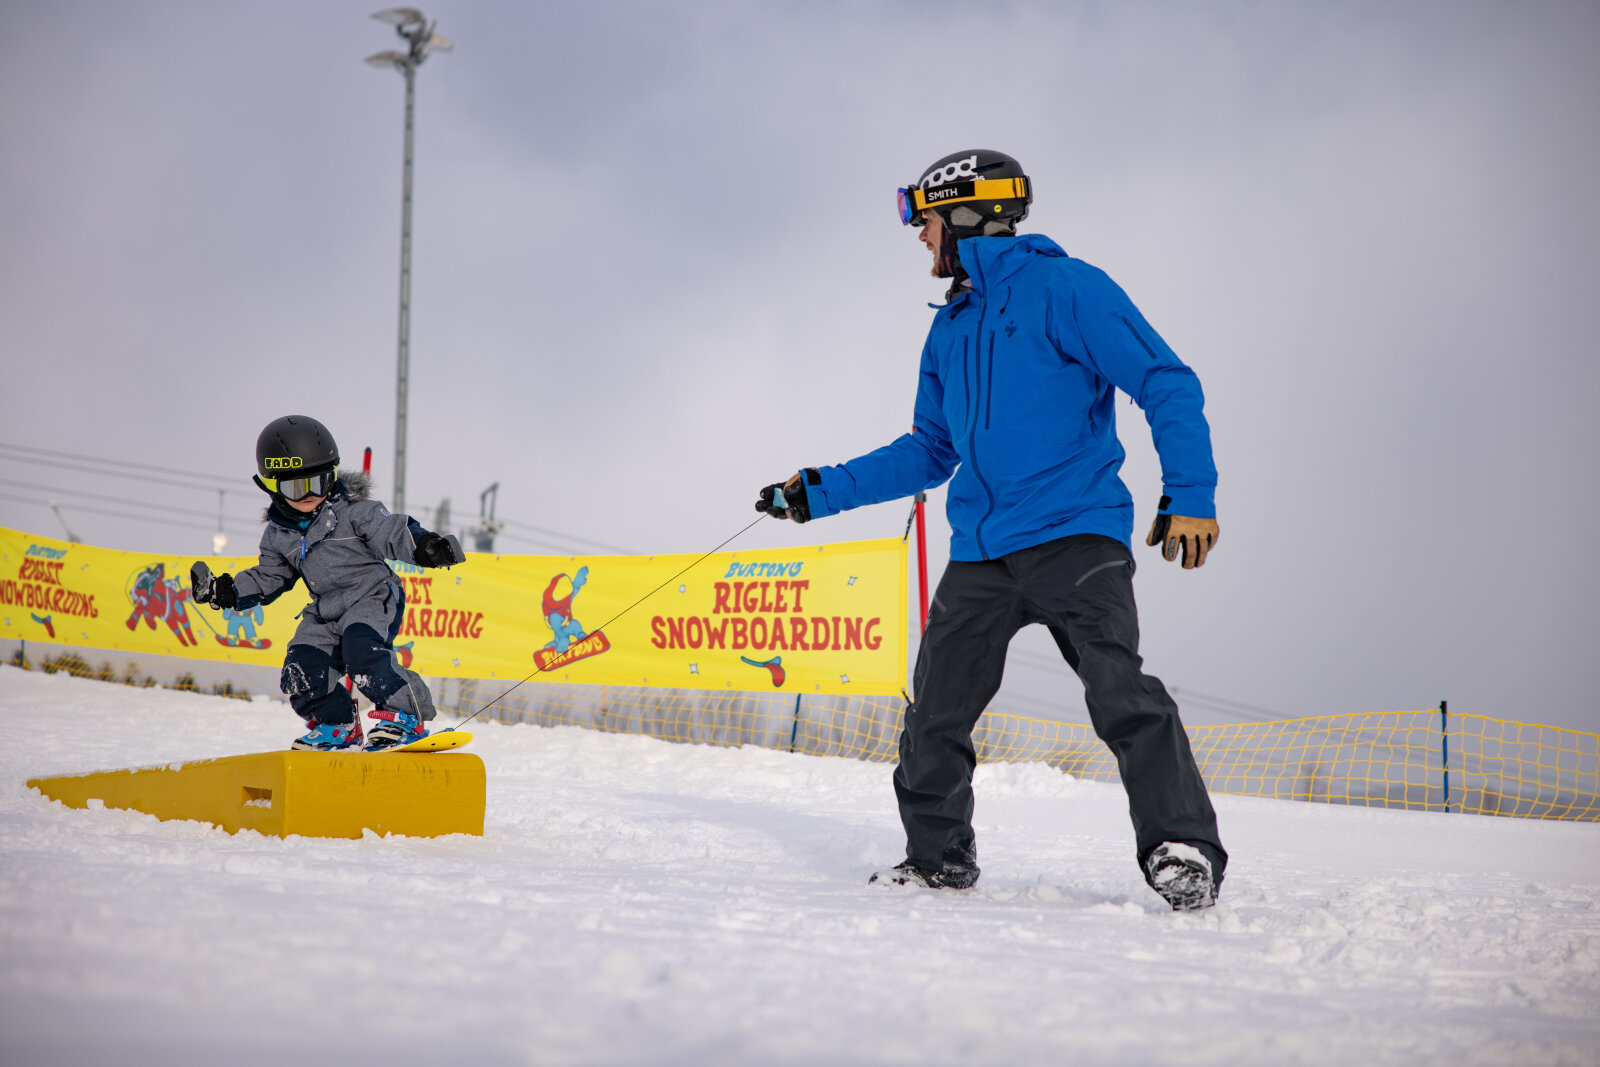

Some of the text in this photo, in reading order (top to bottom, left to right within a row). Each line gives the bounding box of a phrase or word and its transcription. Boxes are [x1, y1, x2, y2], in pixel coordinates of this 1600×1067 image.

[928, 187, 958, 201] SMITH
[0, 579, 98, 618] NOWBOARDING
[712, 580, 809, 614] RIGLET
[651, 615, 883, 650] SNOWBOARDING
